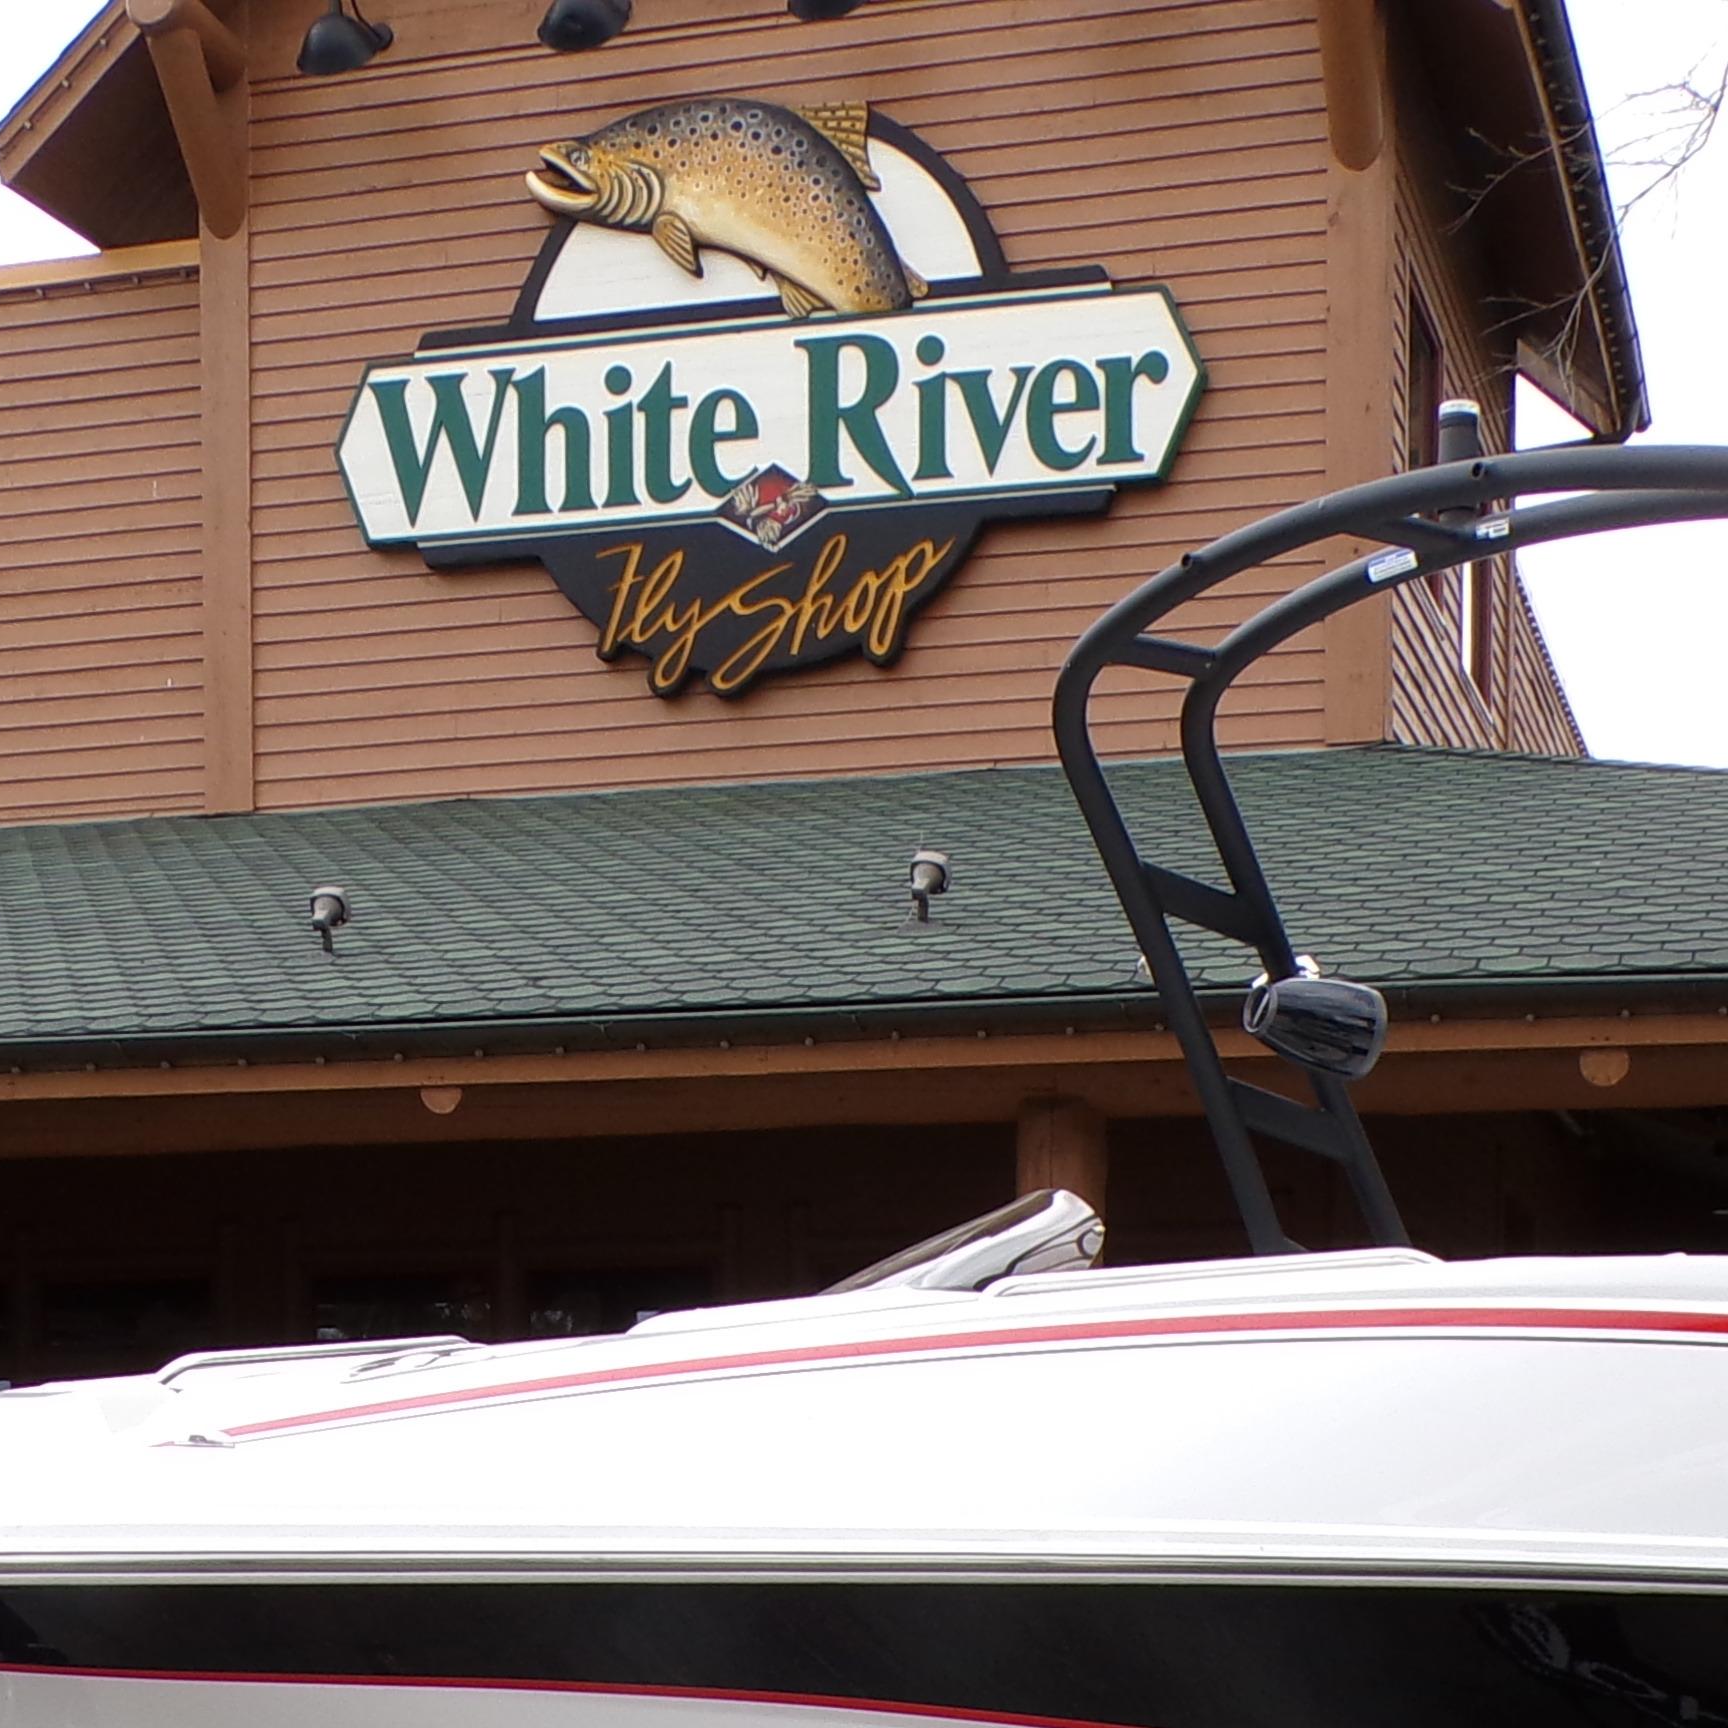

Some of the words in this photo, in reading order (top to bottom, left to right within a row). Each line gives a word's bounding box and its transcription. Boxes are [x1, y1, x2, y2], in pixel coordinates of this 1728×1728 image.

[366, 360, 759, 528] White
[795, 332, 1169, 499] River
[595, 541, 704, 696] Fly
[706, 533, 957, 696] Shop
